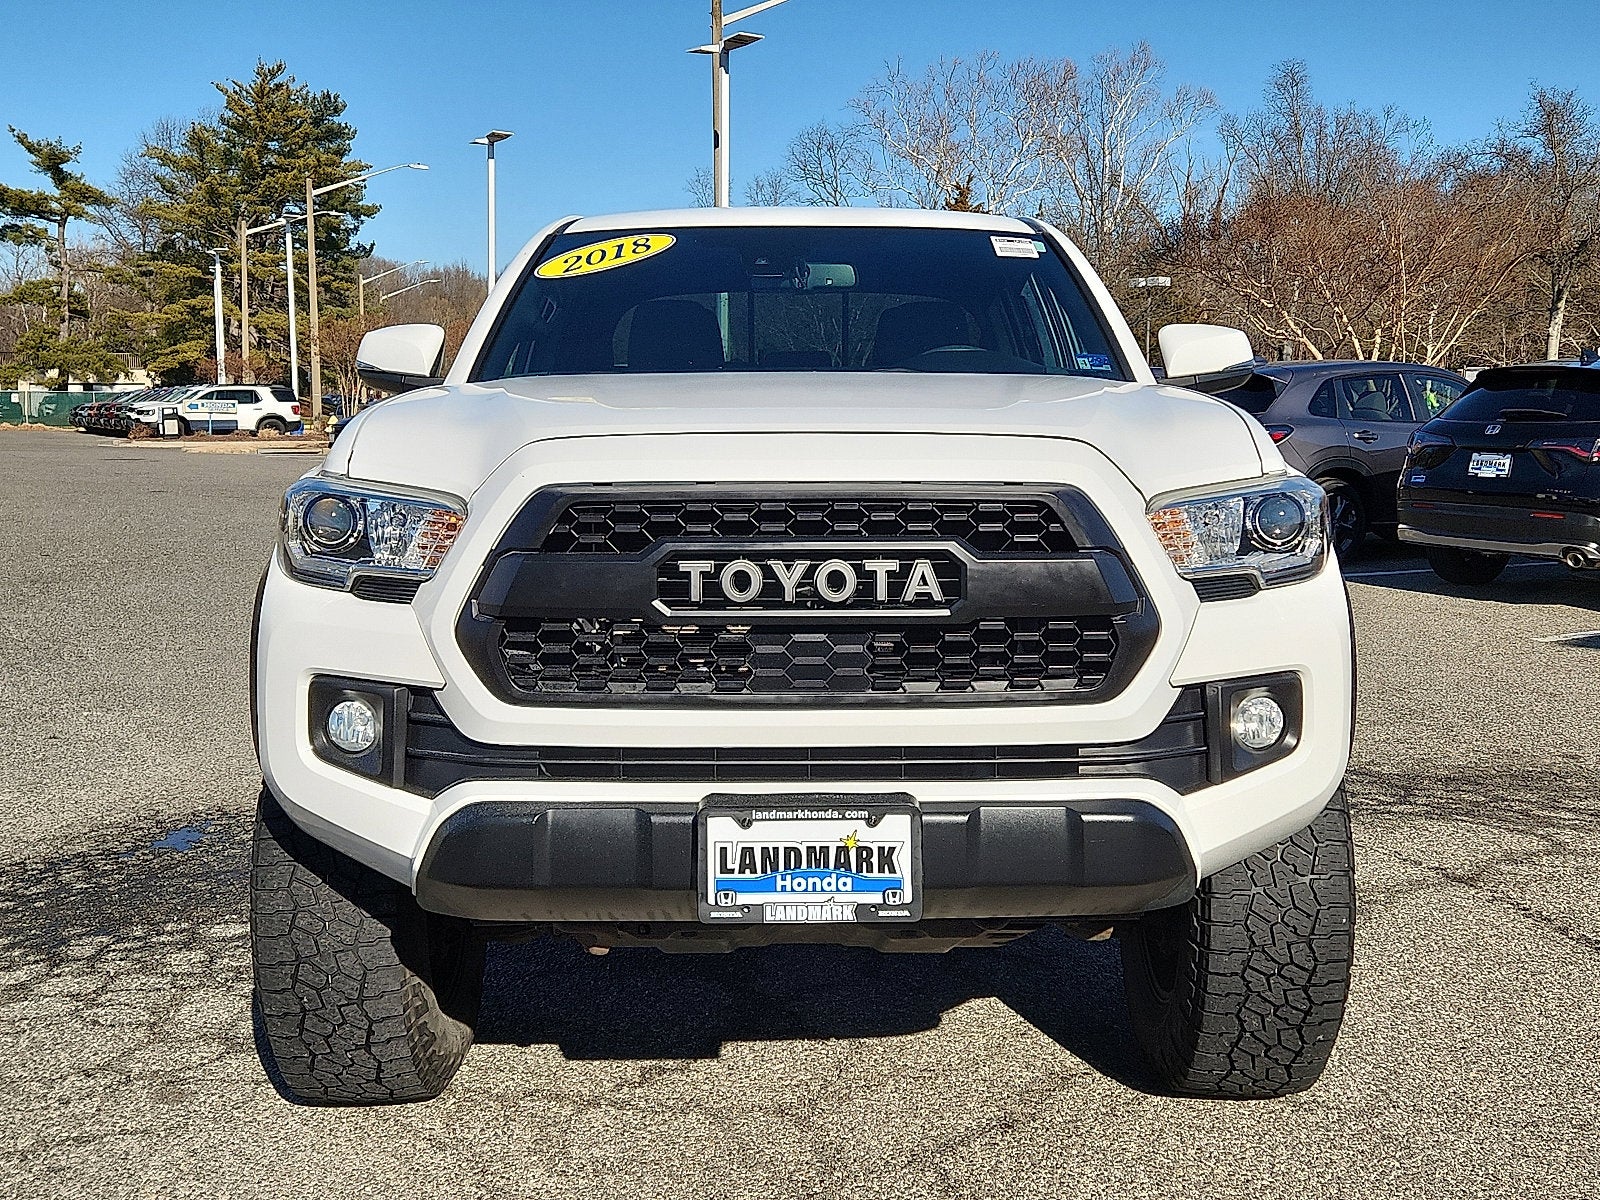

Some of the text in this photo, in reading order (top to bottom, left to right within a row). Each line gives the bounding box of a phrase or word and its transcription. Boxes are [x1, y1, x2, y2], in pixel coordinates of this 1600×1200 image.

[562, 237, 652, 274] 2018
[677, 558, 944, 603] TOYOTA
[719, 845, 897, 874] LANDMARK
[776, 873, 853, 892] Honda
[765, 904, 856, 921] LANDMARK
